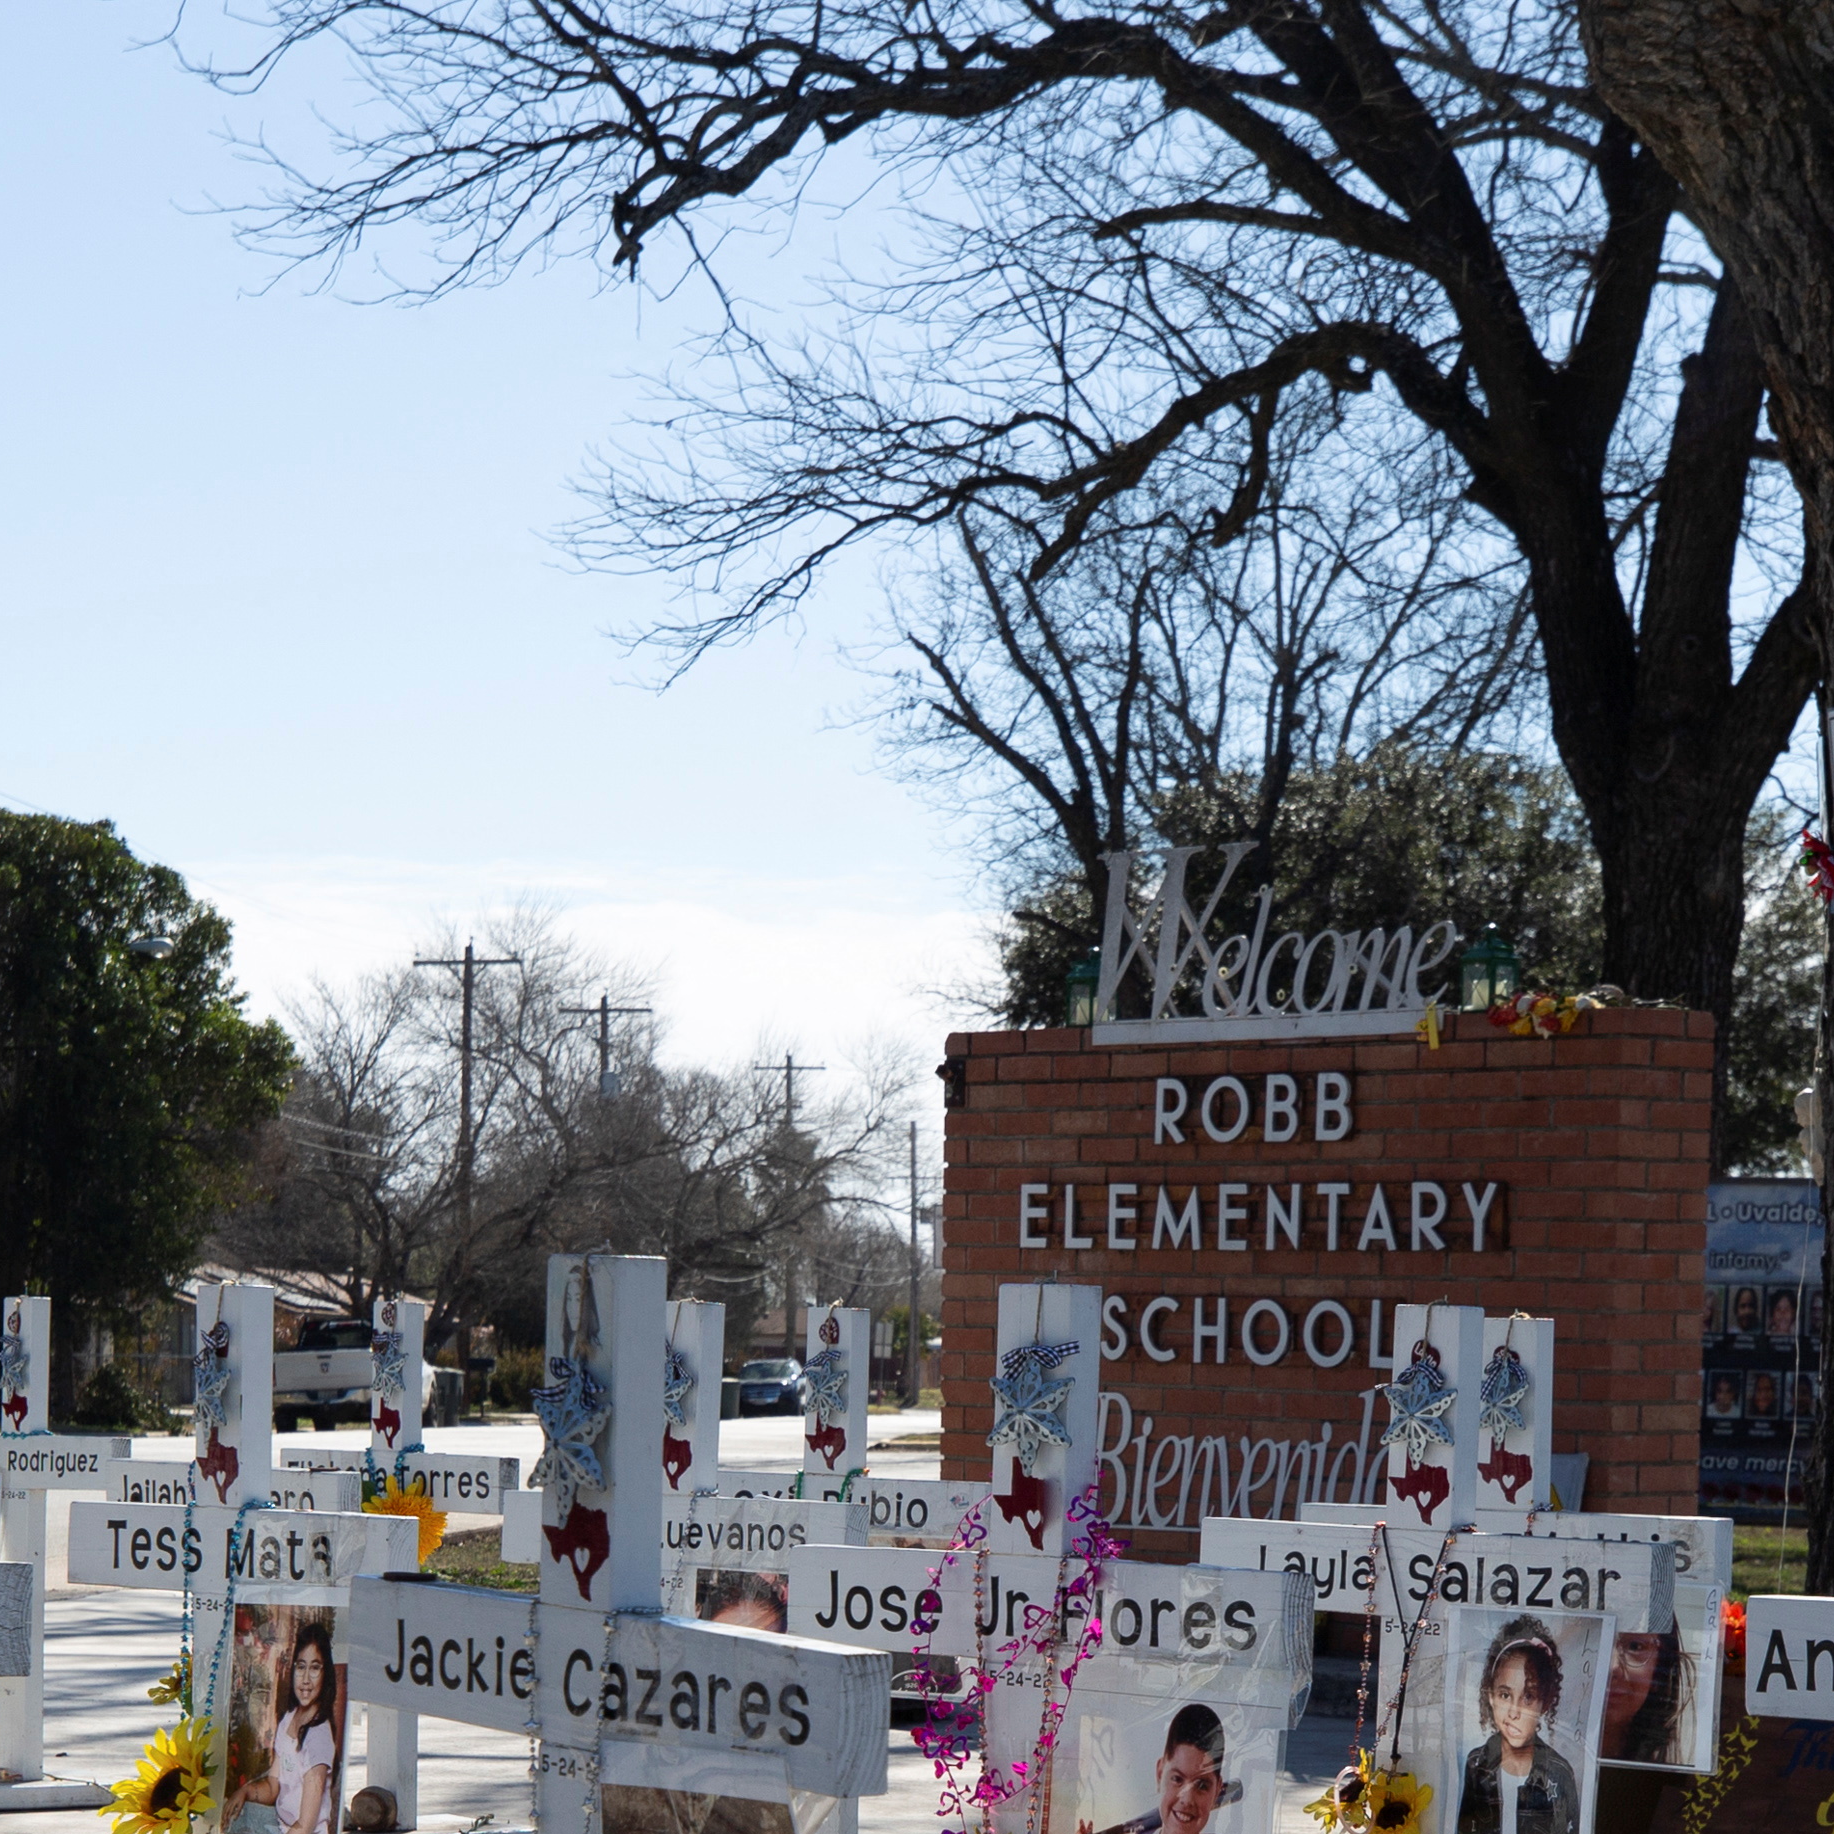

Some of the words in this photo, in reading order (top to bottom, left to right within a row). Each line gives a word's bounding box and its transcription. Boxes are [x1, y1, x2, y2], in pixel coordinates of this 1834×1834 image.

[1096, 841, 1458, 1021] Welcome
[1154, 1073, 1353, 1144] ROBB
[1018, 1181, 1499, 1253] ELEMENTARY
[1100, 1295, 1394, 1369] SCHOOL
[8, 1450, 99, 1478] Rodriguez
[1701, 1454, 1739, 1470] ave
[107, 1519, 203, 1573] Tess
[224, 1528, 332, 1581] Mata
[661, 1521, 807, 1551] uevanos
[815, 1570, 943, 1632] Jose
[980, 1575, 1030, 1637] Jr
[1059, 1585, 1259, 1651] Flores
[1408, 1553, 1622, 1611] Salazar
[384, 1618, 536, 1700] Jackie
[563, 1648, 810, 1745] Cazares
